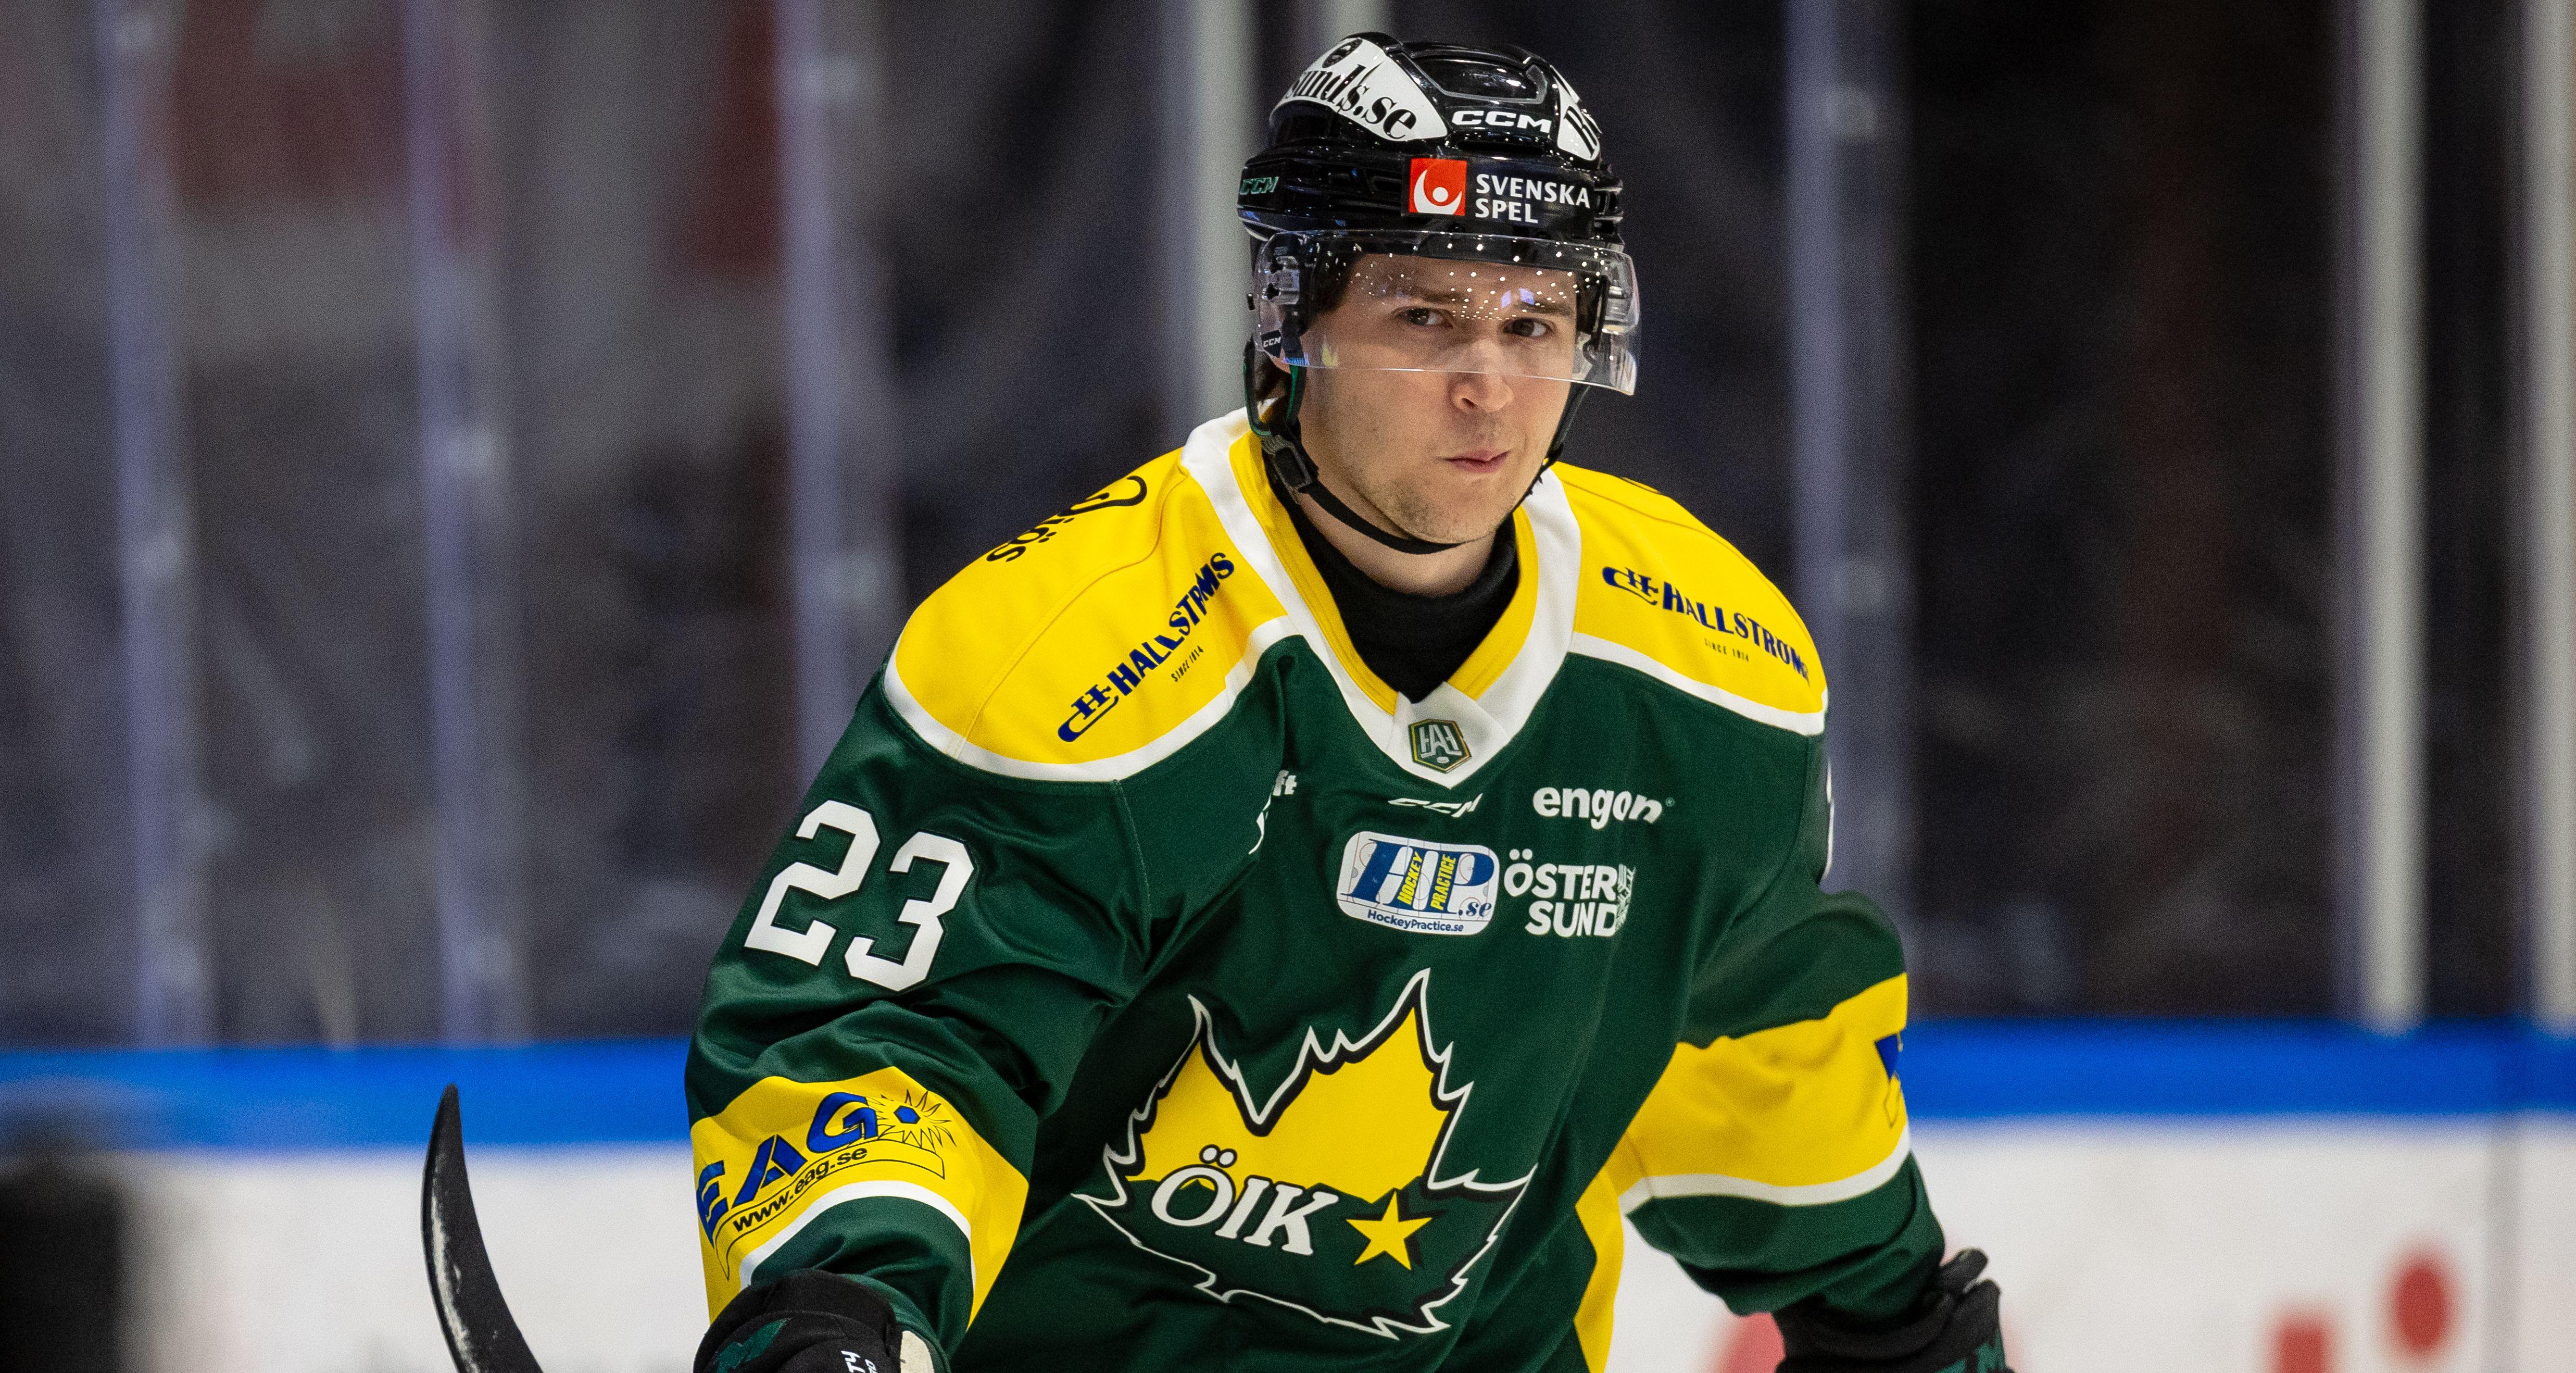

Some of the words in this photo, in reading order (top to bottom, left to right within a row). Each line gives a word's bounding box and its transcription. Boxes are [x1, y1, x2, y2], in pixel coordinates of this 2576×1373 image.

[1451, 110, 1552, 133] CCM
[1475, 197, 1539, 224] SPEL
[1476, 173, 1591, 209] SVENSKA
[1263, 336, 1281, 347] CCM
[1171, 659, 1190, 682] SINCE
[744, 800, 975, 992] 23
[1397, 851, 1423, 905] HOCKEY
[1429, 854, 1456, 910] PRACTICE
[1504, 848, 1618, 901] ÖSTER
[1367, 909, 1464, 932] HockeyPractice.se
[1525, 900, 1618, 938] SUND
[696, 1091, 878, 1249] EAG
[733, 1147, 868, 1233] www.eag.se
[1150, 1144, 1339, 1256] ÖIK
